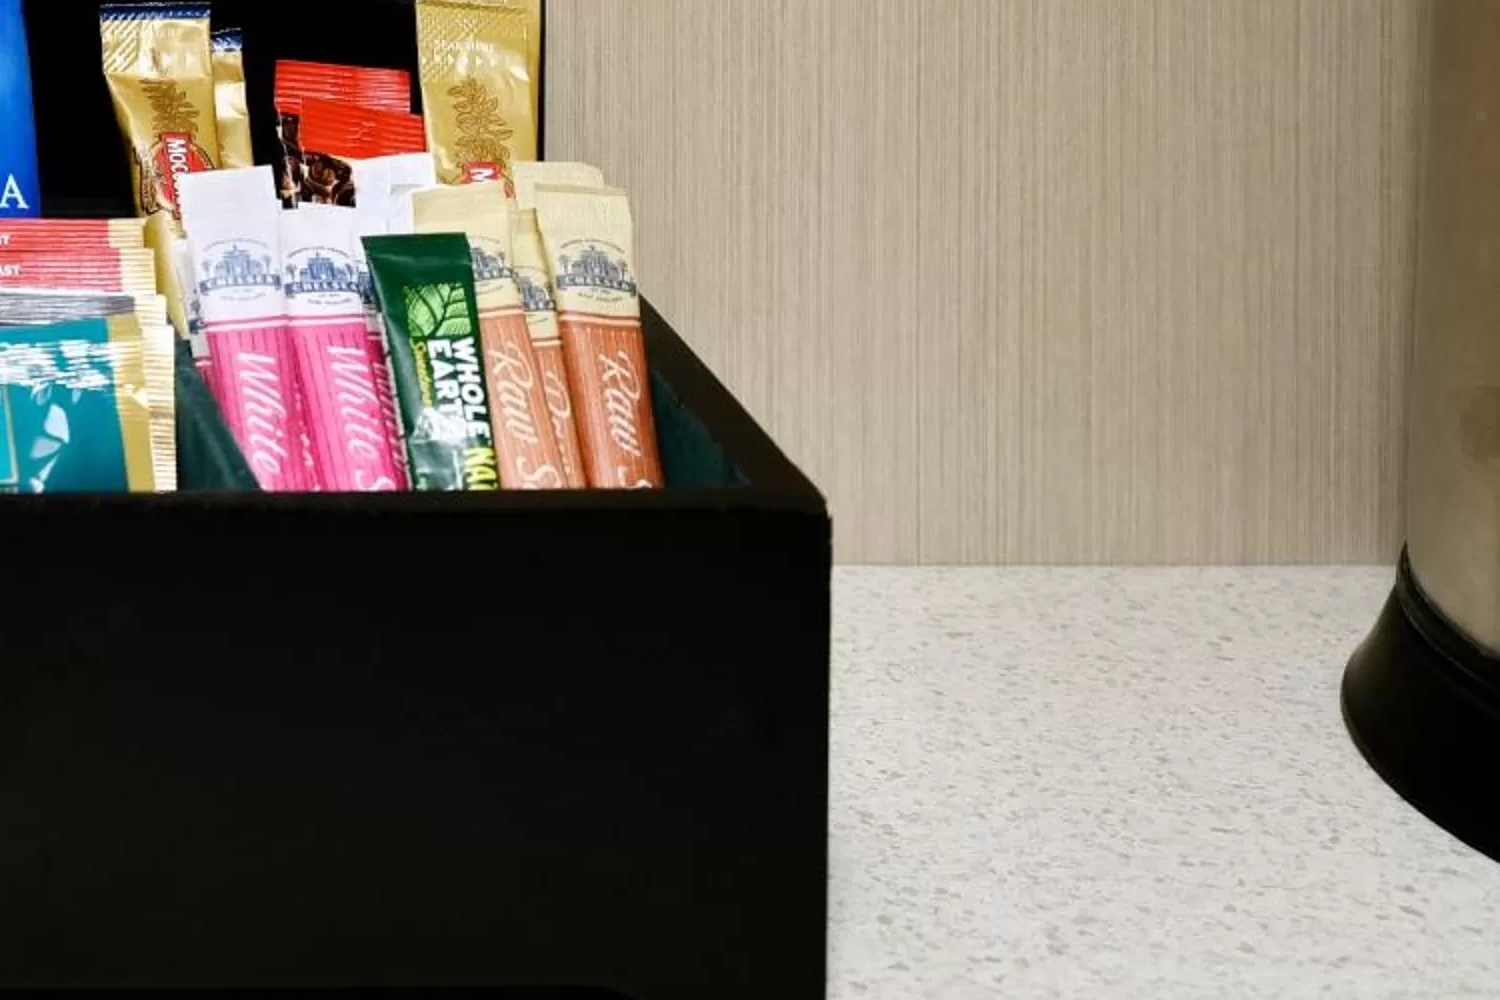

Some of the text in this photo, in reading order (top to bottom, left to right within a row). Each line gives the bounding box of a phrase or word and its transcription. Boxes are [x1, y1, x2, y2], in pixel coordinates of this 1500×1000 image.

[237, 351, 288, 473] White
[325, 345, 384, 459] White
[452, 337, 491, 438] WHOLE
[489, 340, 539, 444] Raw
[599, 350, 642, 456] Raw
